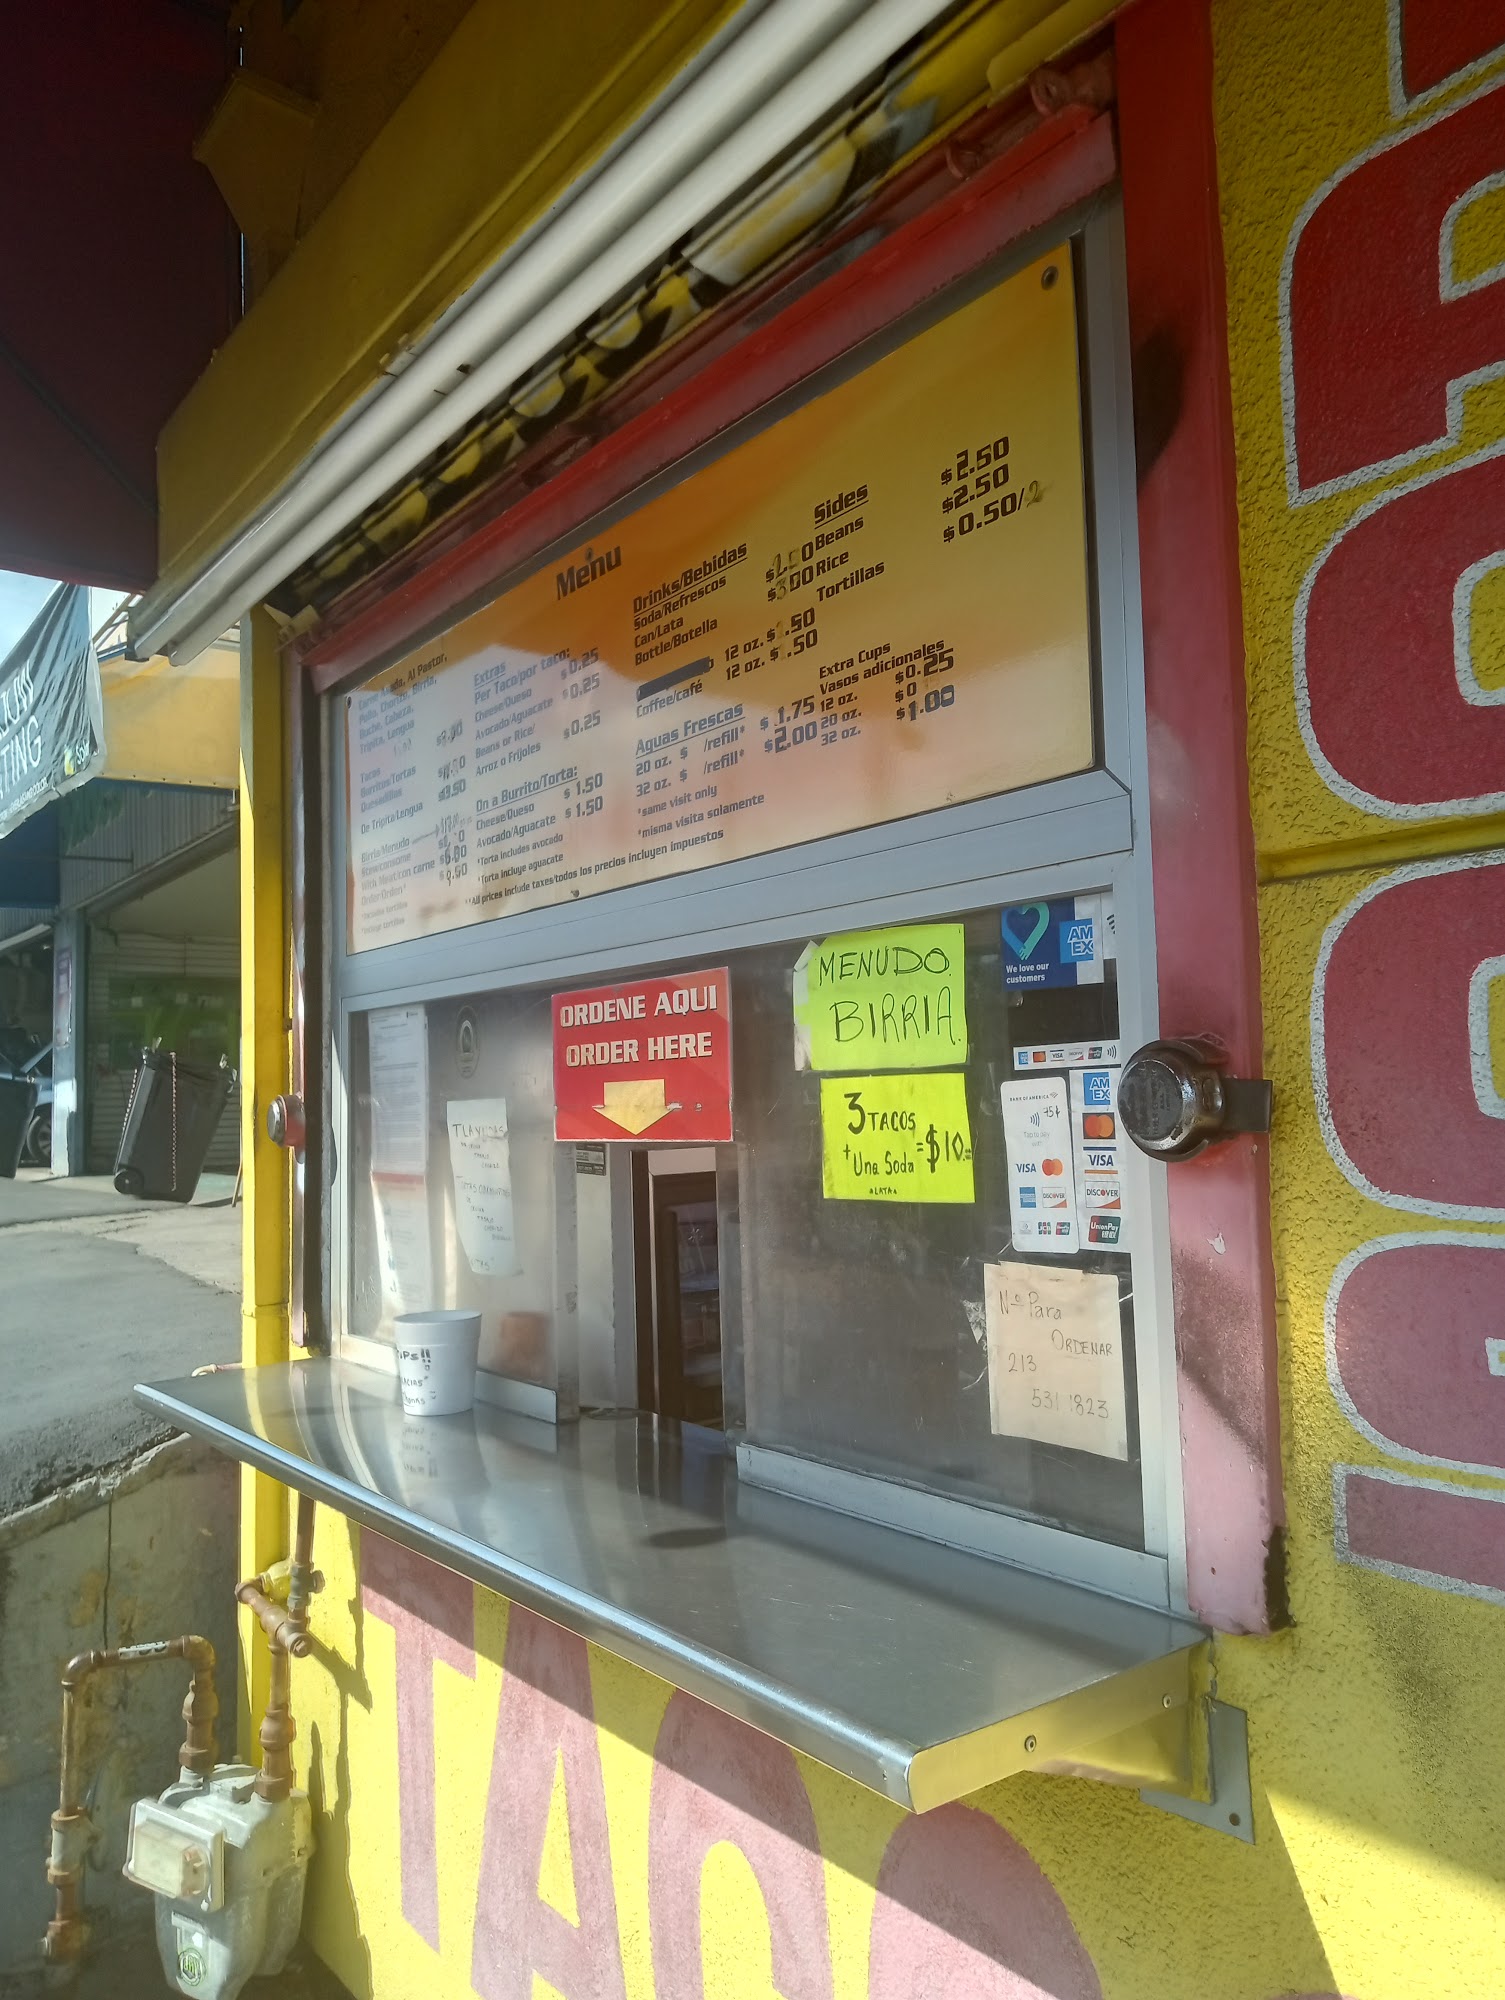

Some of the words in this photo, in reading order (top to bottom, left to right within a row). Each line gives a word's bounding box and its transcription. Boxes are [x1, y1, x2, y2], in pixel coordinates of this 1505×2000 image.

[814, 484, 868, 525] Sides
[816, 551, 849, 577] Rice
[942, 463, 1009, 514] $2.50
[815, 516, 864, 551] Beans
[556, 546, 621, 600] Menu
[633, 543, 747, 614] Drinks/Bebidas
[817, 561, 885, 602] Tortillas
[634, 576, 726, 631] Soda/Refrescos
[635, 617, 684, 648] Can/Lata
[635, 618, 718, 666] Bottle/Botella
[724, 644, 739, 661] 12
[743, 638, 764, 654] oz.
[407, 668, 416, 680] Al
[418, 653, 447, 676] Pastor,
[474, 662, 506, 687] Extras
[475, 689, 491, 705] Per
[495, 664, 537, 694] Taco/por
[541, 648, 570, 671] taco:
[561, 648, 599, 680] $0.25
[819, 658, 854, 679] Extra
[858, 642, 890, 662] Cups
[819, 672, 859, 695] Vasos
[863, 640, 945, 679] adicionales
[636, 679, 703, 719] Coffee/café
[726, 663, 741, 680] 12
[744, 657, 765, 674] oz.
[820, 699, 834, 712] 12
[838, 692, 858, 706] oz.
[895, 647, 954, 684] $0.25
[476, 698, 553, 740] Avocado/Aguacate
[562, 672, 600, 699] $0.25
[821, 731, 837, 746] 32
[842, 726, 861, 740] oz.
[896, 684, 955, 721] $1.00
[821, 714, 837, 729] 20
[842, 707, 862, 722] oz.
[476, 761, 498, 776] Arroz
[500, 757, 506, 766] o
[508, 742, 541, 762] Frijoles
[563, 710, 600, 739] $0.25
[636, 730, 679, 756] Aguas
[683, 703, 743, 738] Frescas
[475, 741, 500, 758] Beans
[503, 736, 512, 746] or
[636, 782, 650, 797] 32
[654, 778, 671, 792] oz.
[679, 769, 688, 782] $
[764, 720, 818, 754] $2.00
[636, 760, 650, 776] 20
[654, 755, 672, 770] oz.
[680, 746, 688, 760] $
[476, 799, 489, 812] On
[492, 796, 499, 804] a
[501, 766, 578, 803] Burrito/Torta:
[670, 792, 692, 808] visit
[695, 784, 718, 800] only
[476, 803, 535, 831] Cheese/Queso
[675, 812, 705, 828] visita
[707, 794, 765, 819] solamente
[361, 823, 370, 834] De
[476, 815, 556, 848] Avocado/Aguacate
[500, 844, 530, 860] includes
[532, 833, 564, 849] avocado
[481, 891, 503, 905] prices
[504, 882, 530, 897] include
[532, 868, 578, 889] taxes/todos
[580, 866, 592, 877] los
[594, 856, 626, 874] precios
[628, 844, 667, 863] incluyen
[670, 829, 724, 852] impuestos
[501, 865, 527, 879] incluye
[528, 853, 564, 871] aguacate
[1006, 964, 1018, 974] We
[1019, 963, 1035, 973] love
[1036, 964, 1050, 972] our
[1006, 974, 1046, 984] customers
[560, 995, 646, 1027] ORDENE
[654, 985, 717, 1016] AQUI
[566, 1039, 639, 1067] ORDER
[647, 1031, 713, 1061] HERE
[1090, 1077, 1110, 1089] AM
[843, 1092, 866, 1135] 3
[867, 1110, 917, 1132] TACOS
[853, 1151, 879, 1176] Una
[884, 1150, 914, 1175] Soda
[1016, 1163, 1037, 1173] VISA
[1088, 1154, 1114, 1167] VISA
[1028, 1291, 1061, 1320] Para
[1008, 1353, 1037, 1372] 213
[1032, 1389, 1059, 1411] 531
